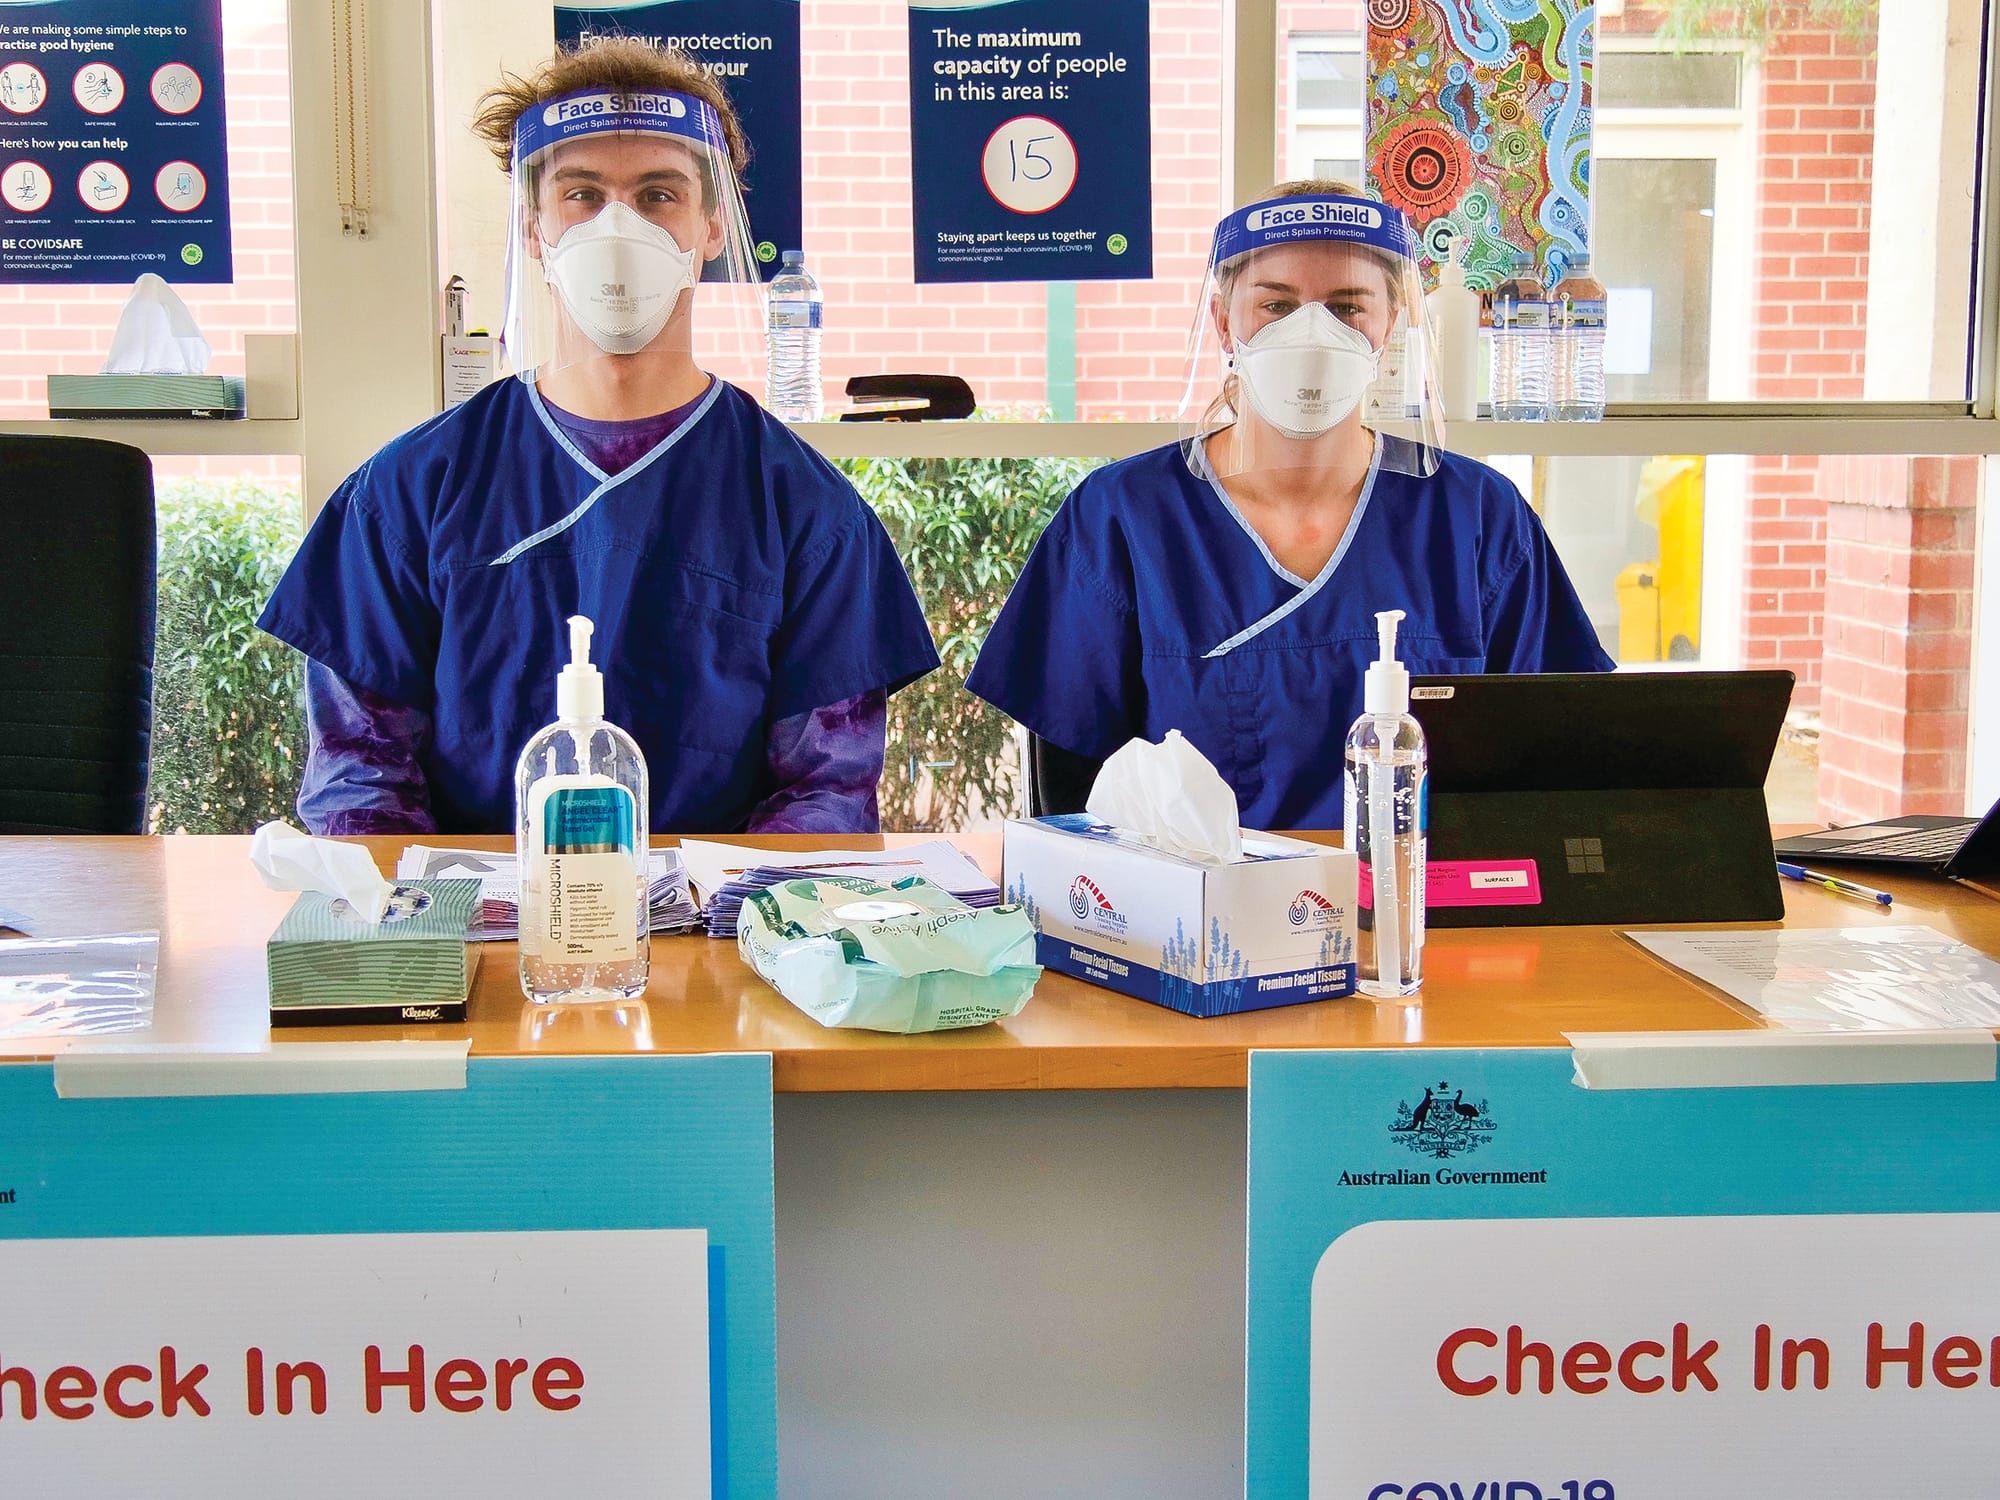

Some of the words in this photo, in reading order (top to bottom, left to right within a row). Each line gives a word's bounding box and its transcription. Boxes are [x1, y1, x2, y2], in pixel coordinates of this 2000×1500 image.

[13, 26, 30, 35] are
[32, 24, 70, 37] making
[74, 26, 102, 35] some
[106, 24, 140, 39] simple
[143, 25, 172, 37] steps
[174, 25, 187, 35] to
[932, 27, 972, 48] The
[977, 27, 1081, 47] maximum
[0, 39, 37, 49] ractise
[40, 39, 68, 52] good
[71, 39, 114, 52] hygiene
[668, 31, 773, 54] protection
[702, 61, 750, 80] your
[933, 54, 1023, 80] capacity
[1027, 52, 1051, 73] of
[1056, 52, 1127, 79] people
[934, 82, 953, 101] in
[958, 80, 996, 101] this
[1001, 85, 1044, 100] area
[1049, 81, 1069, 100] is:
[557, 101, 604, 121] Face
[609, 95, 672, 115] Shield
[563, 121, 590, 134] Direct
[590, 117, 622, 129] Splash
[623, 117, 669, 128] Protection
[0, 138, 29, 149] Here's
[32, 137, 55, 149] how
[58, 140, 79, 152] you
[81, 140, 100, 149] can
[103, 137, 128, 151] help
[1009, 136, 1055, 182] 15
[1260, 209, 1306, 228] Face
[1311, 204, 1370, 225] Shield
[938, 232, 975, 245] Staying
[977, 232, 1003, 244] apart
[1006, 231, 1036, 243] keeps
[1038, 232, 1049, 241] us
[1052, 229, 1097, 242] together
[1264, 230, 1290, 241] Direct
[1291, 227, 1322, 238] Splash
[1323, 227, 1366, 239] Protection
[2, 239, 16, 249] BE
[18, 239, 84, 249] COVIDSAFE
[966, 246, 1003, 254] information
[1004, 245, 1022, 253] about
[1059, 244, 1093, 253] (COVID-19)
[3, 253, 13, 261] For
[34, 253, 71, 261] information
[73, 253, 91, 261] about
[93, 253, 130, 261] coronavirus
[131, 252, 166, 262] (COVID-19)
[938, 255, 1004, 263] coronavirus.vic.gov.au
[3, 263, 73, 271] coronavirus.vic.gov.au
[601, 283, 626, 297] 3M
[1296, 388, 1322, 401] 3M
[561, 799, 607, 807] MICROSHIELD
[561, 806, 590, 815] ANGEL
[561, 815, 610, 824] Antimicrobial
[561, 824, 581, 832] Hand
[583, 824, 595, 832] Gel
[549, 858, 562, 940] MICROSHIELD
[1093, 906, 1128, 924] CENTRAL
[1313, 907, 1345, 916] CENTRAL
[926, 911, 980, 937] Asepti
[1070, 946, 1093, 966] Premium
[1092, 953, 1109, 970] Facial
[1109, 958, 1129, 977] Tissues
[1257, 975, 1293, 992] Premium
[1293, 970, 1317, 987] Facial
[1317, 968, 1347, 984] Tissues
[402, 1006, 440, 1019] Kleenex
[938, 1012, 990, 1020] DISINFECTANT
[940, 1005, 974, 1015] HOSPITAL
[975, 1005, 1001, 1014] GRADE
[1337, 1168, 1431, 1186] Australian
[1435, 1167, 1547, 1185] Government
[1436, 1322, 1719, 1396] Check
[1754, 1323, 1830, 1392] In
[0, 1345, 211, 1420] heck
[246, 1346, 327, 1416] In
[364, 1344, 585, 1413] Here
